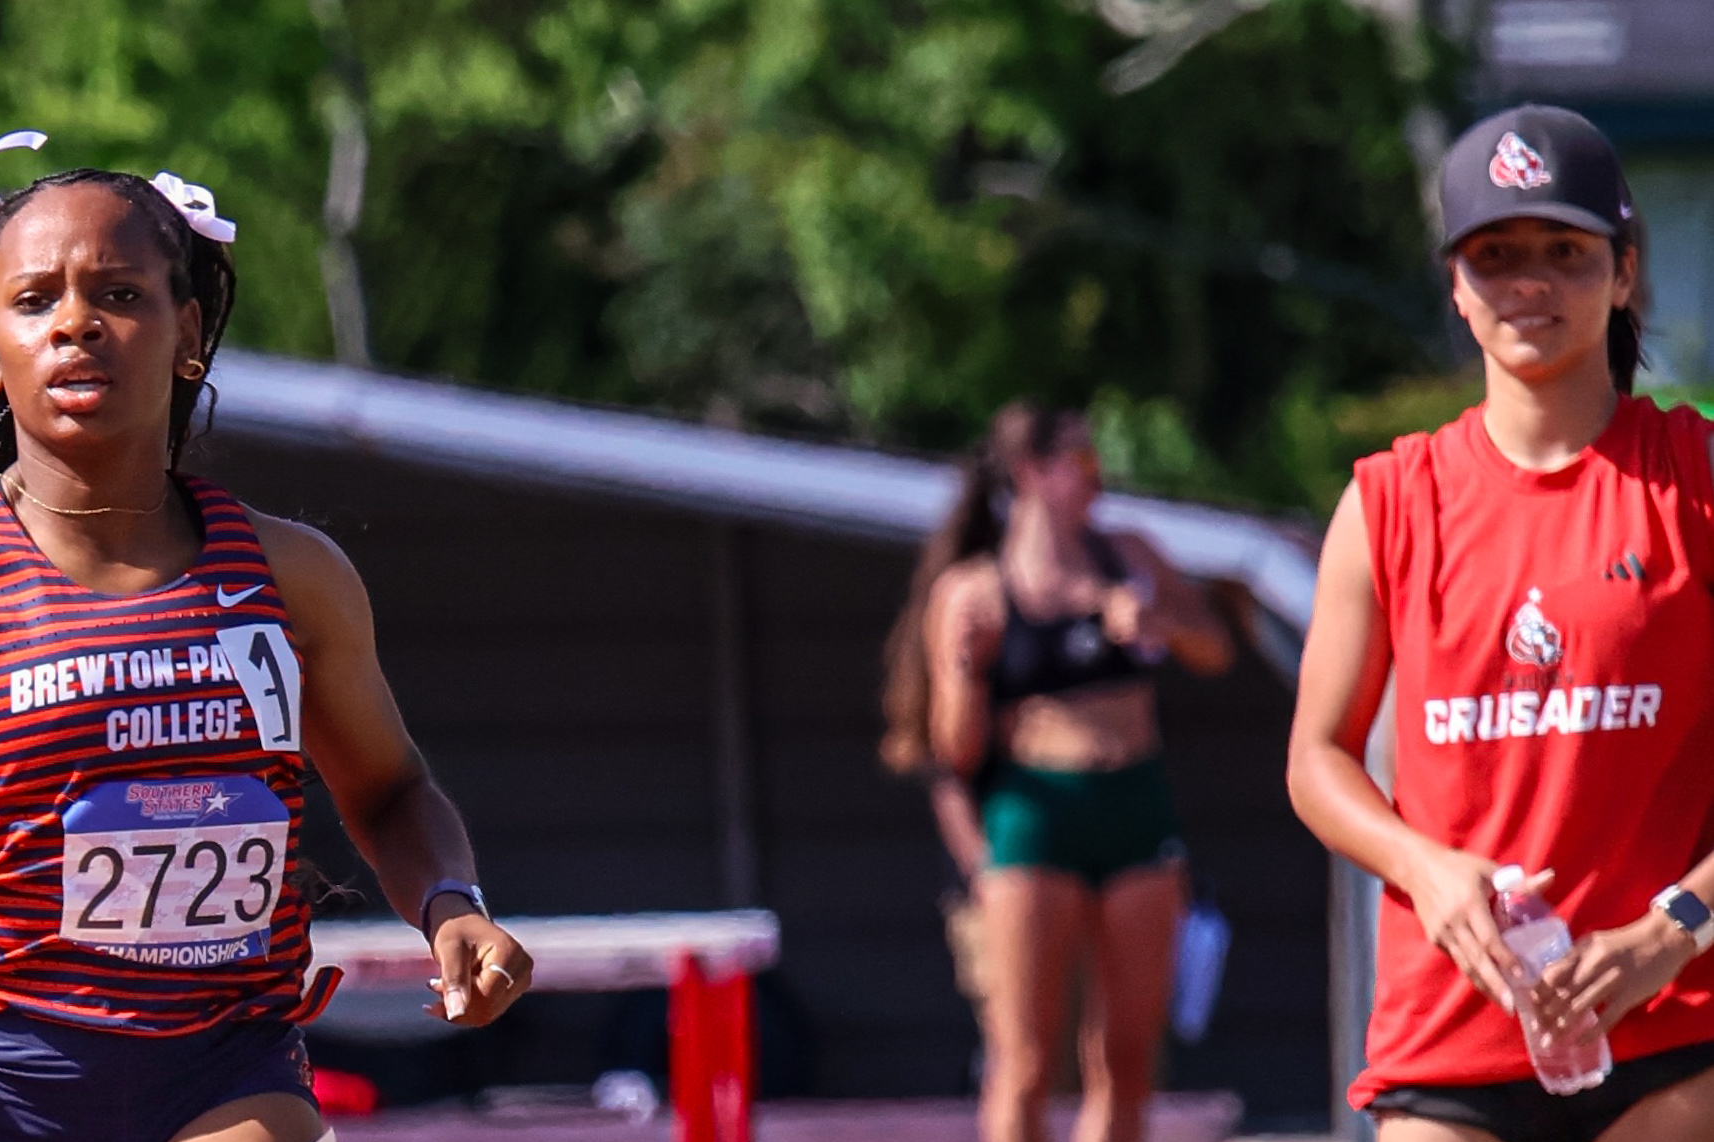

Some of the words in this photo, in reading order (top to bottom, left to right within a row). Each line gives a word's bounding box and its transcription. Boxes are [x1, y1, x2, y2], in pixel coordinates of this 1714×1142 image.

[10, 643, 237, 714] BREWTON-PA
[106, 697, 244, 753] COLLEGE
[1424, 683, 1663, 745] CRUSADER
[127, 781, 214, 804] SOUTHERN
[141, 797, 202, 817] STATES
[76, 837, 275, 929] 2723
